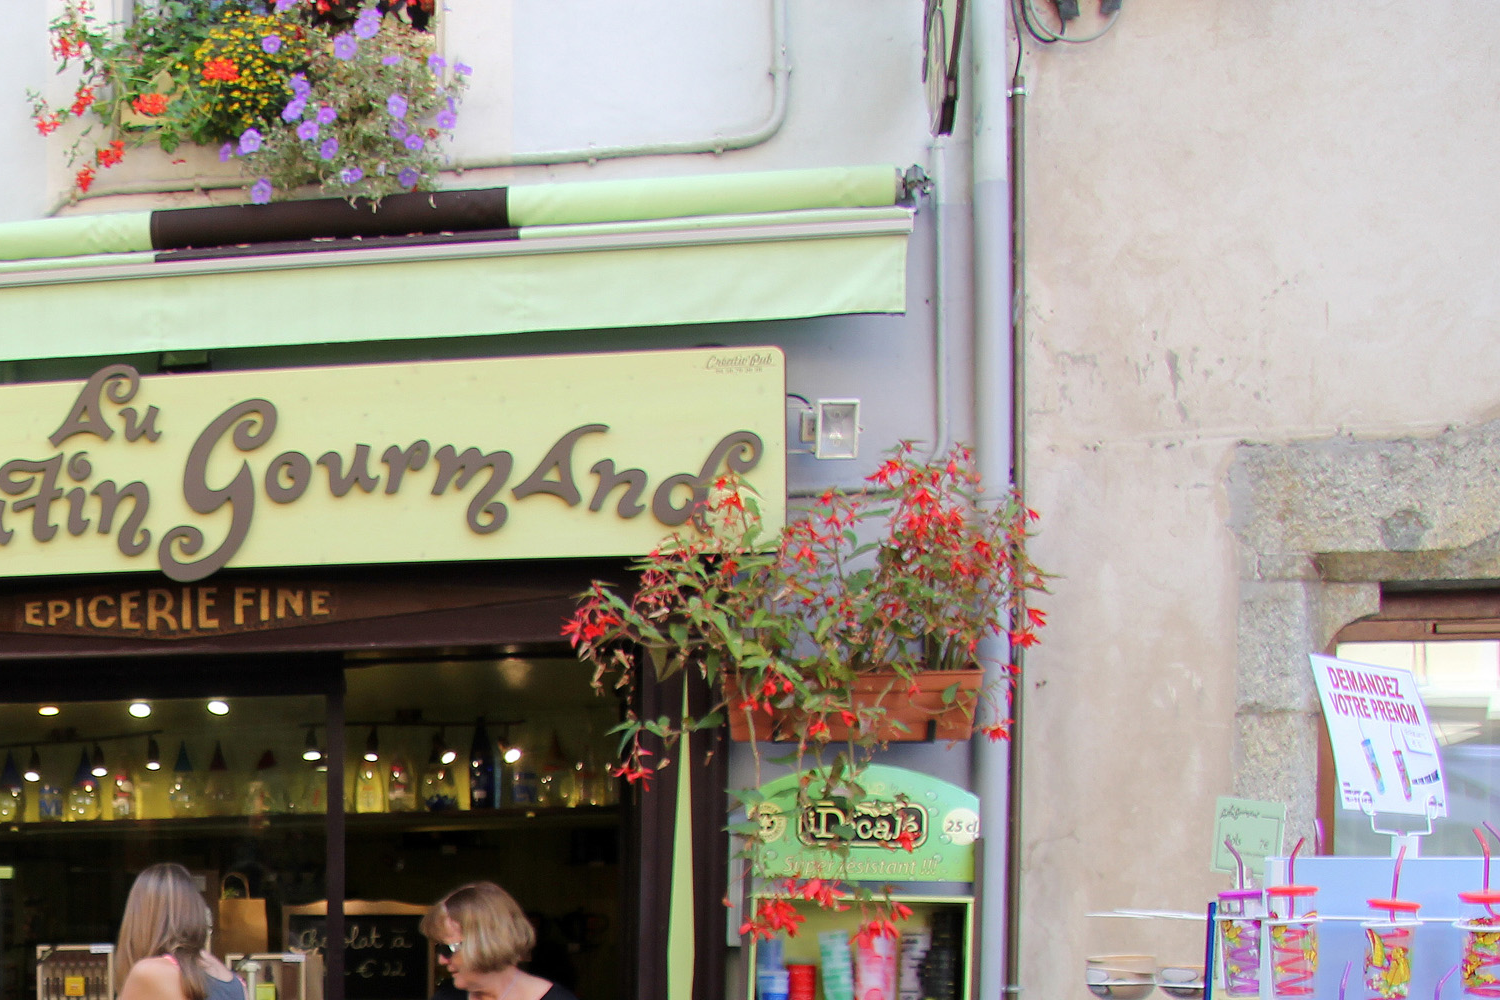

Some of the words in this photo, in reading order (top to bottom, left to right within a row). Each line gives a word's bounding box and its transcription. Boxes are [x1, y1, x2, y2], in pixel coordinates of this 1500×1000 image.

[49, 364, 163, 449] Au
[25, 587, 219, 631] EPICERIE
[234, 587, 331, 625] FINE
[1326, 666, 1404, 699] DEMANDEZ
[1328, 691, 1372, 719] VOTRE
[1369, 698, 1420, 726] PRENOM
[946, 819, 964, 833] 25
